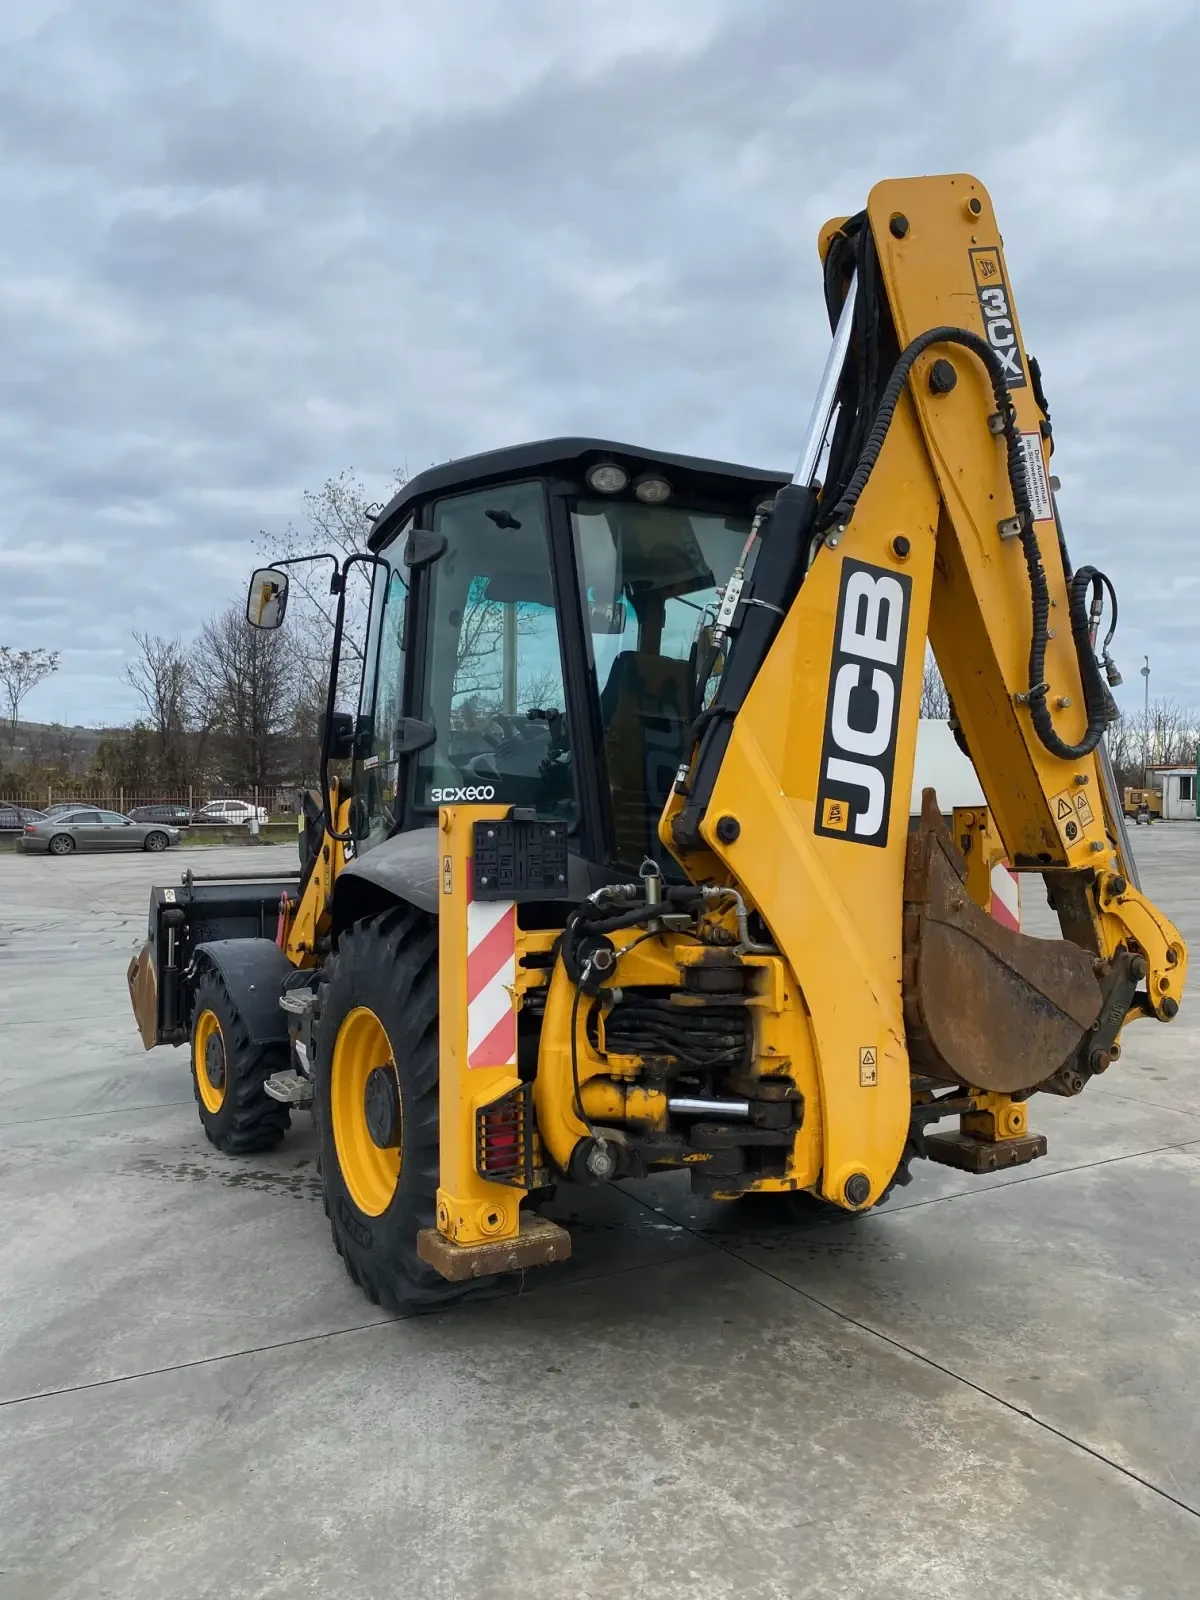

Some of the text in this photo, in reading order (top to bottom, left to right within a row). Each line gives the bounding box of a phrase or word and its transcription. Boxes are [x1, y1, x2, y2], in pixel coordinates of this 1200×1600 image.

[979, 260, 996, 277] JCB
[982, 288, 1023, 374] 3CX
[1026, 440, 1042, 514] im Schwenkbereich
[1036, 464, 1047, 504] Aufenthalt
[826, 571, 904, 836] JCB
[431, 785, 495, 802] 3CXeco
[829, 804, 842, 823] JCB
